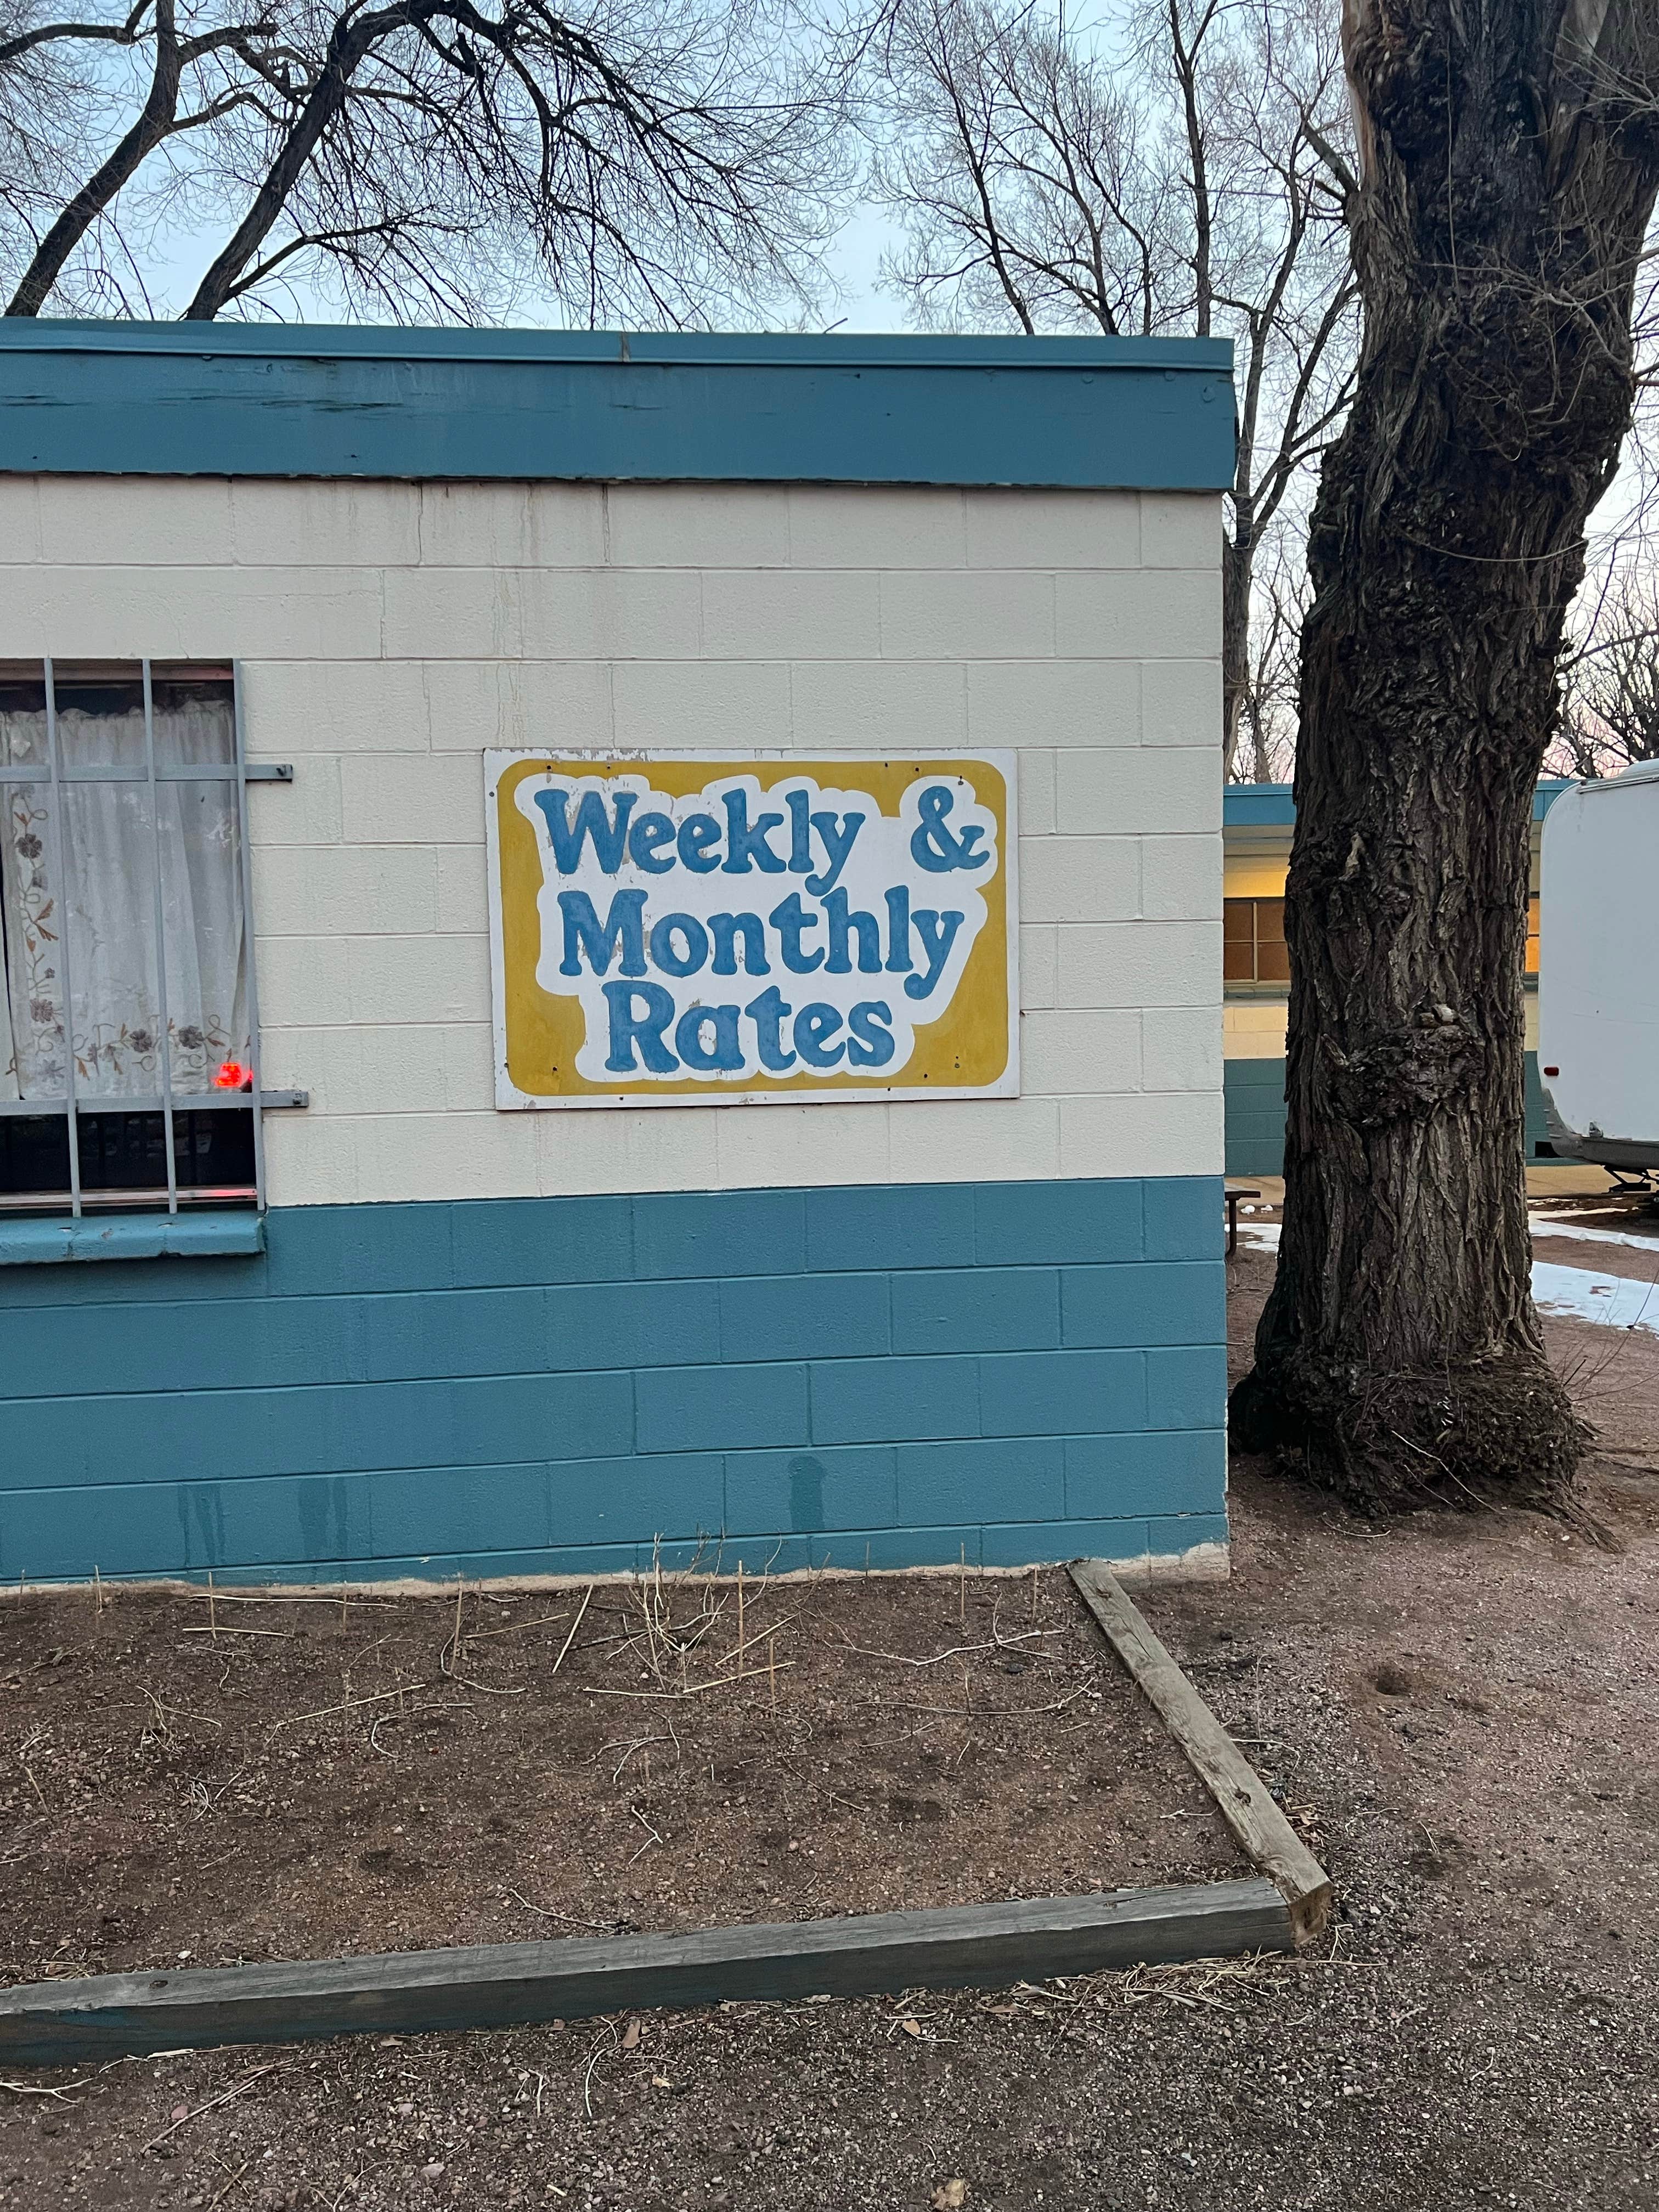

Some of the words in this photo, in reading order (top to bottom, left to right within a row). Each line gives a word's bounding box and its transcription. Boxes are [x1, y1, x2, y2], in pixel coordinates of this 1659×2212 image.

[534, 788, 866, 896] Weekly
[910, 786, 990, 873] &
[557, 885, 966, 1000] Monthly
[602, 980, 896, 1073] Rates
